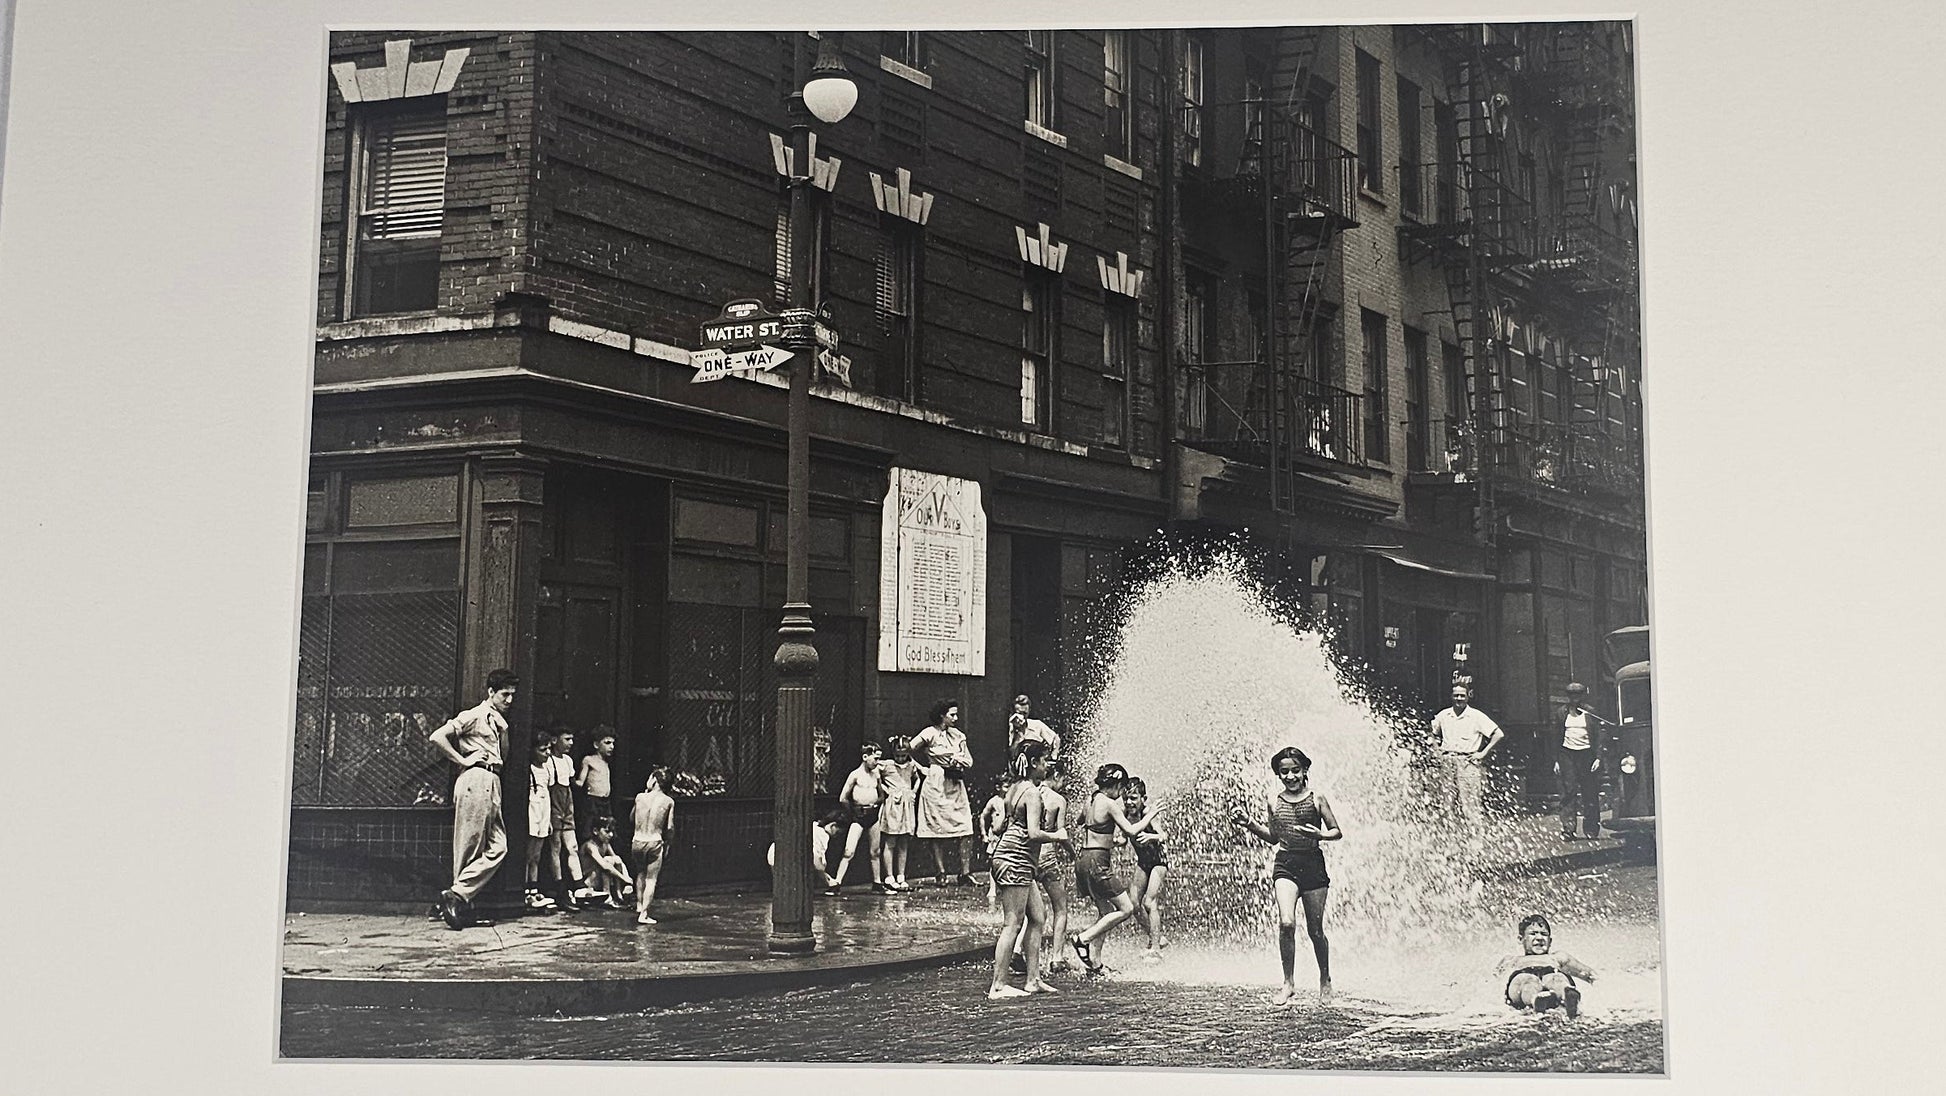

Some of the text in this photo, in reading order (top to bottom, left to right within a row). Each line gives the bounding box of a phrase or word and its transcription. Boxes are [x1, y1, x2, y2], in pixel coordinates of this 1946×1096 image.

[706, 321, 780, 342] WATER ST.
[905, 644, 922, 662] God
[924, 646, 946, 664] Bless
